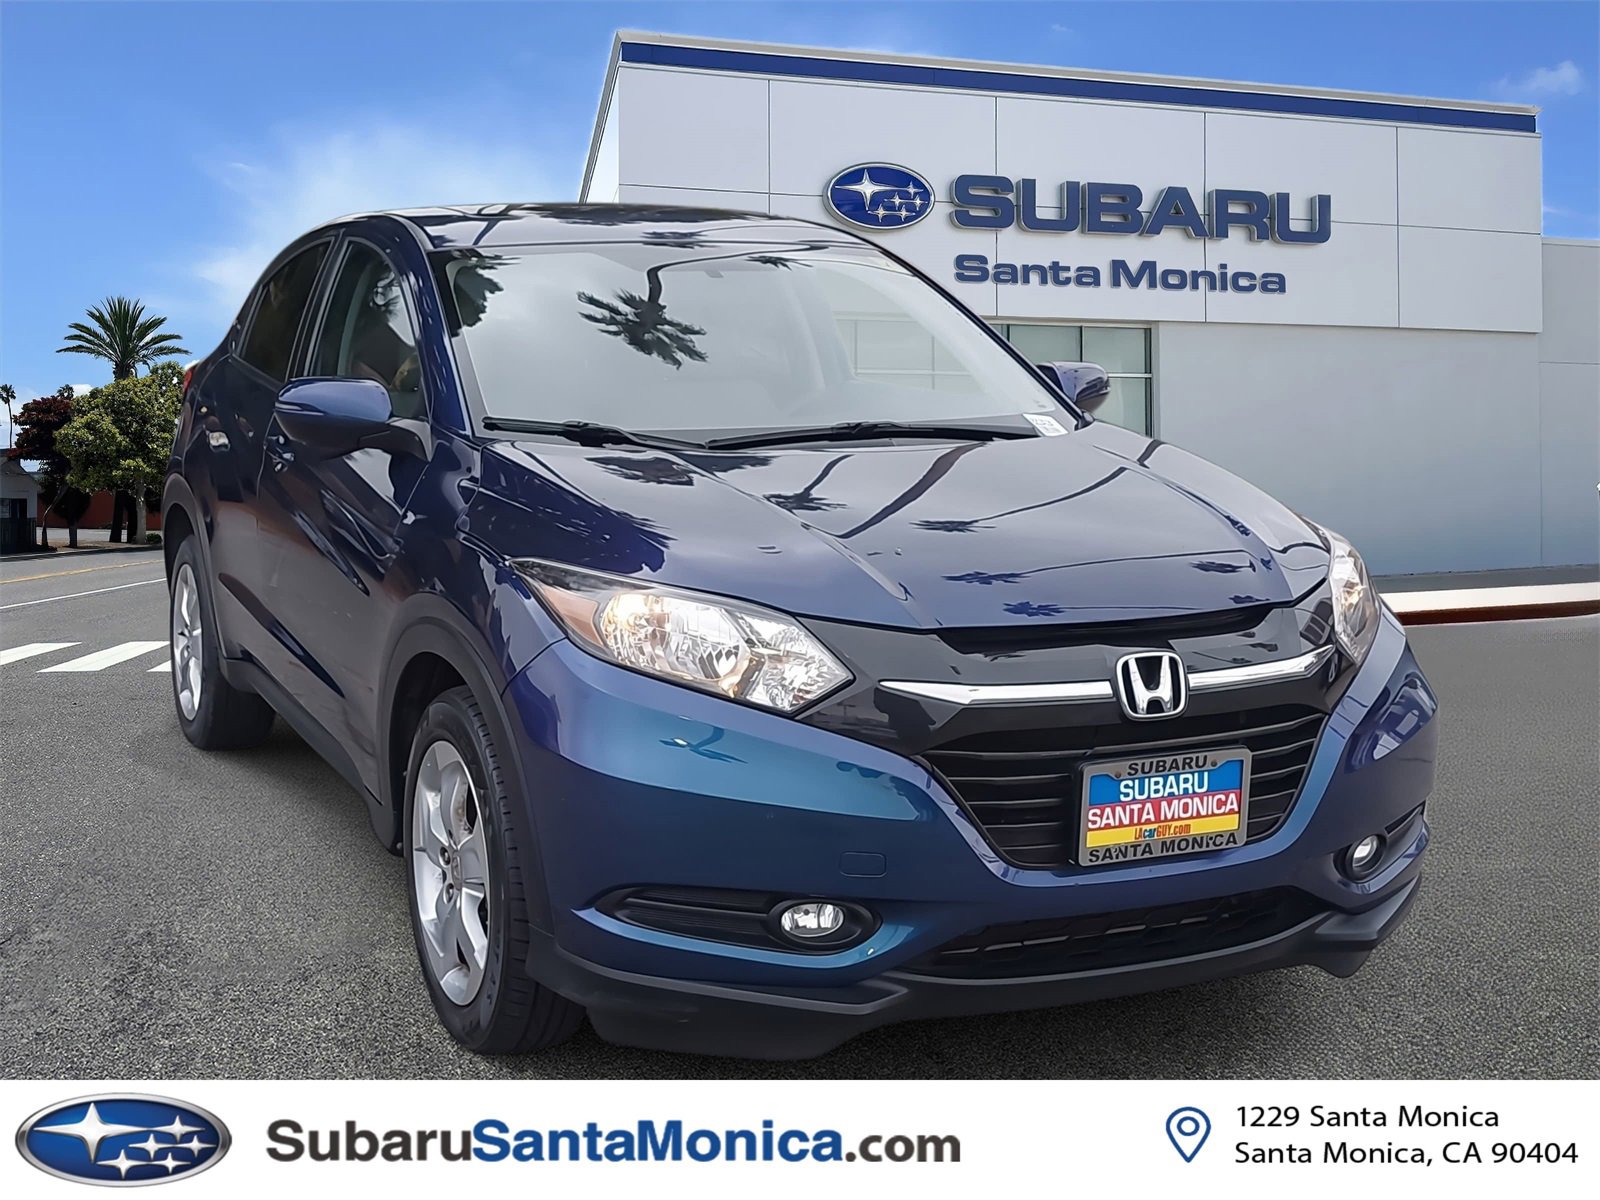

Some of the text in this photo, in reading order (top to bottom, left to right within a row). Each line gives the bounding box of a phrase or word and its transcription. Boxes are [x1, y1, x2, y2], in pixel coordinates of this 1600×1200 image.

[951, 174, 1332, 244] SUBARU
[954, 253, 1288, 295] Santa Monica
[1127, 754, 1208, 777] SUBARU
[1119, 771, 1209, 802] SUBARU
[1087, 793, 1239, 829] SANTA MONICA
[1088, 832, 1238, 863] SANTA MONICA
[1134, 823, 1192, 841] LAcarGUY.com
